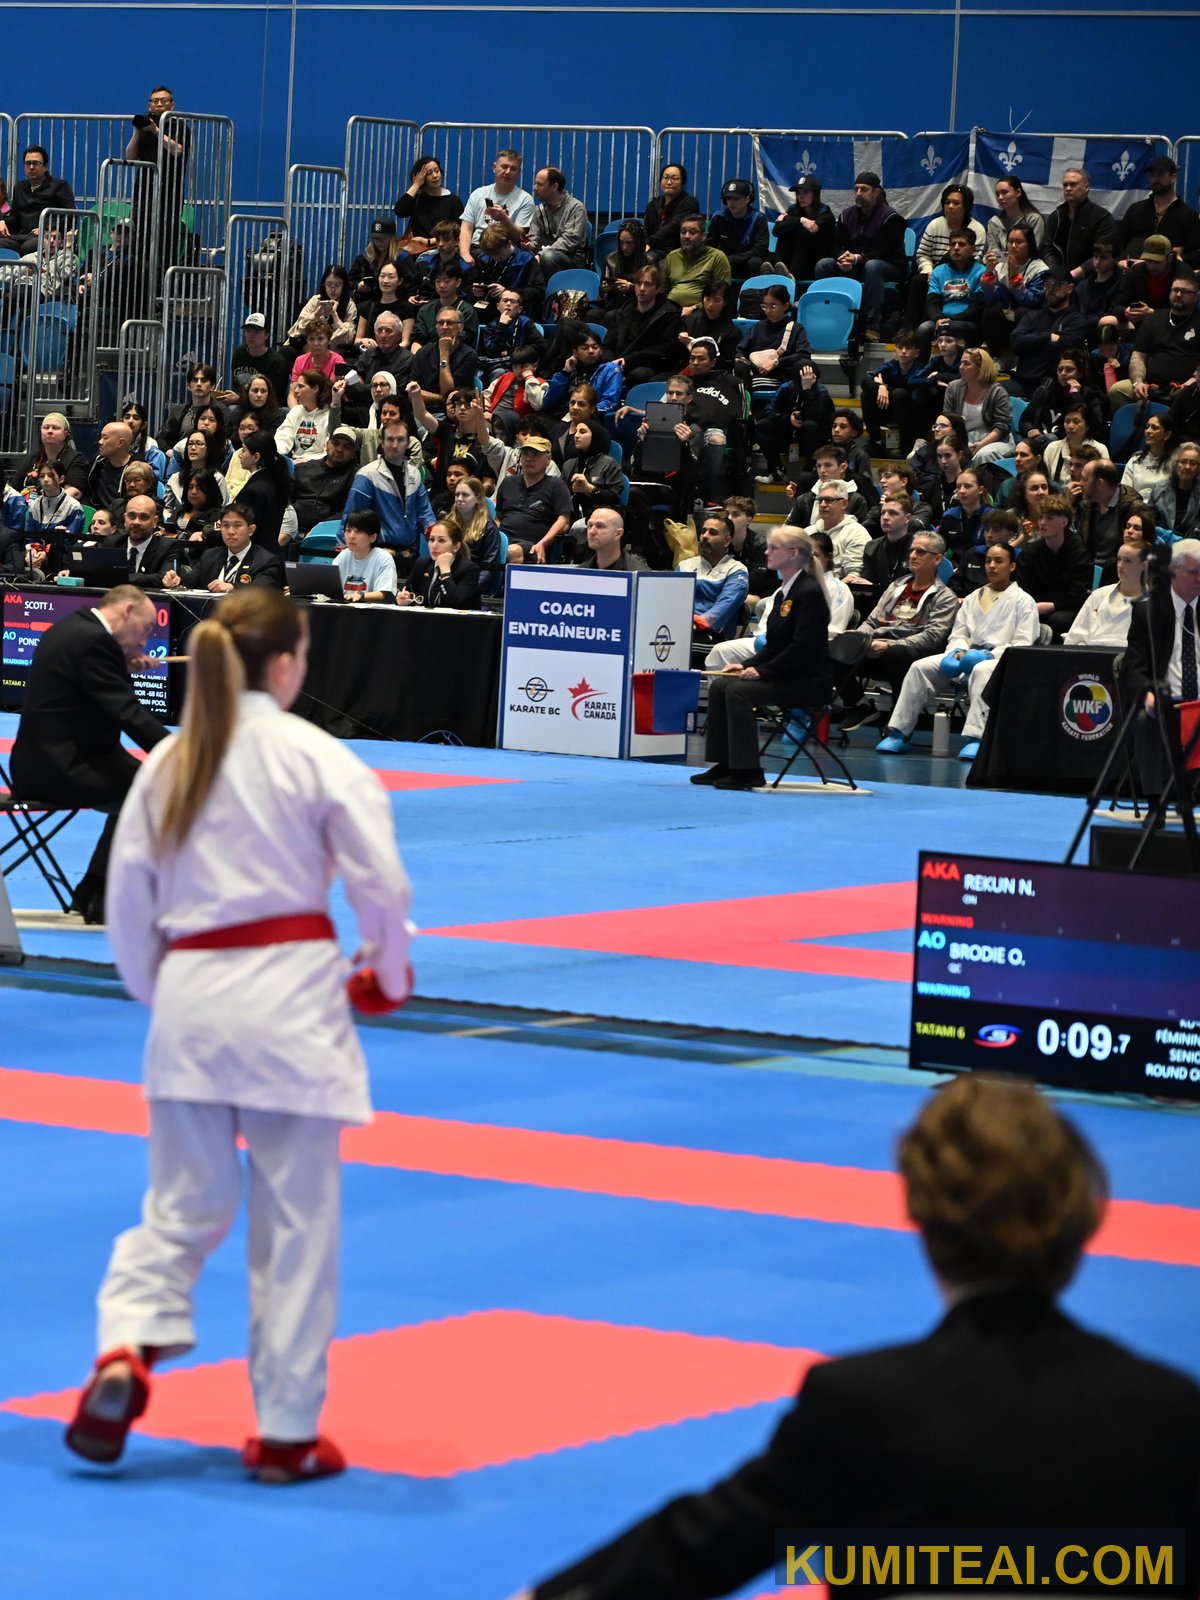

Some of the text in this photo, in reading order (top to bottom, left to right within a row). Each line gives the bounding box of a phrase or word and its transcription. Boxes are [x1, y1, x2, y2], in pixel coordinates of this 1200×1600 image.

[4, 594, 23, 604] AKA
[24, 601, 48, 610] SCOTT
[157, 608, 169, 627] 0
[540, 601, 595, 617] COACH
[3, 631, 16, 640] AO
[508, 621, 621, 642] ENTRAÎNEUR·E
[1078, 673, 1100, 681] WORLD
[509, 704, 561, 716] KARATE BC
[584, 701, 616, 711] KARATE
[1072, 700, 1103, 714] WKF
[584, 710, 617, 721] CANADA
[921, 862, 960, 881] AKA
[964, 873, 1036, 897] REKUN N.
[917, 930, 946, 950] AO
[950, 942, 1026, 966] BRODIE O.
[917, 981, 971, 999] WARNING
[915, 1021, 956, 1039] TATAMI
[1145, 1062, 1188, 1080] ROUND
